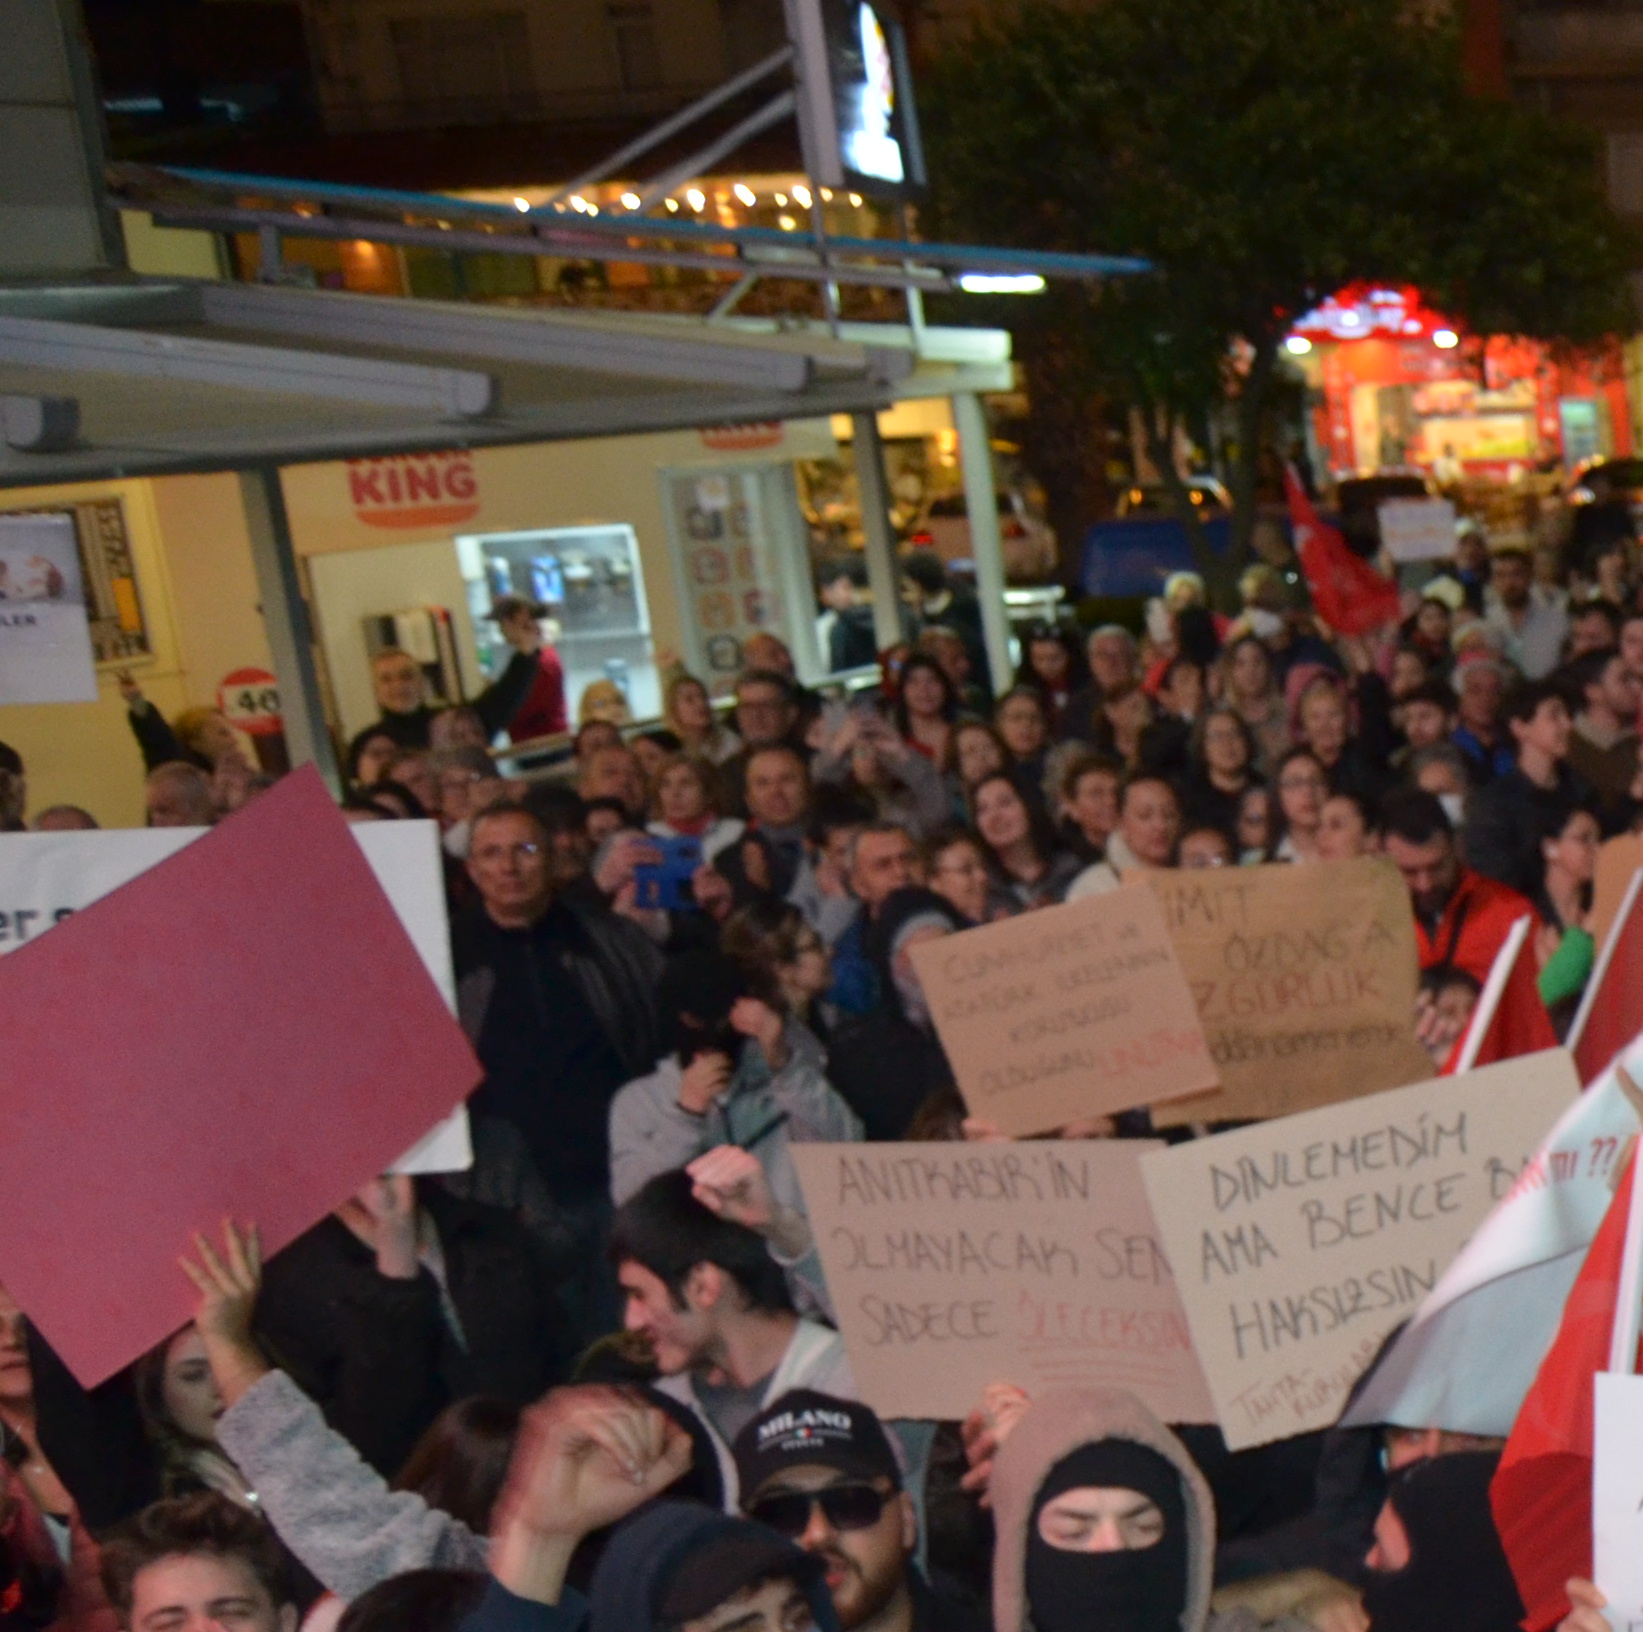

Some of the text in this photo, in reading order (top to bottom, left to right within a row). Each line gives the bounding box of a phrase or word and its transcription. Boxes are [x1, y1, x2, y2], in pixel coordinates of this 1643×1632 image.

[349, 463, 478, 505] KING
[1202, 1223, 1278, 1283] AMA
[1301, 1173, 1465, 1249] BENCE
[861, 1294, 999, 1347] SADECE
[758, 1408, 852, 1439] MILANO
